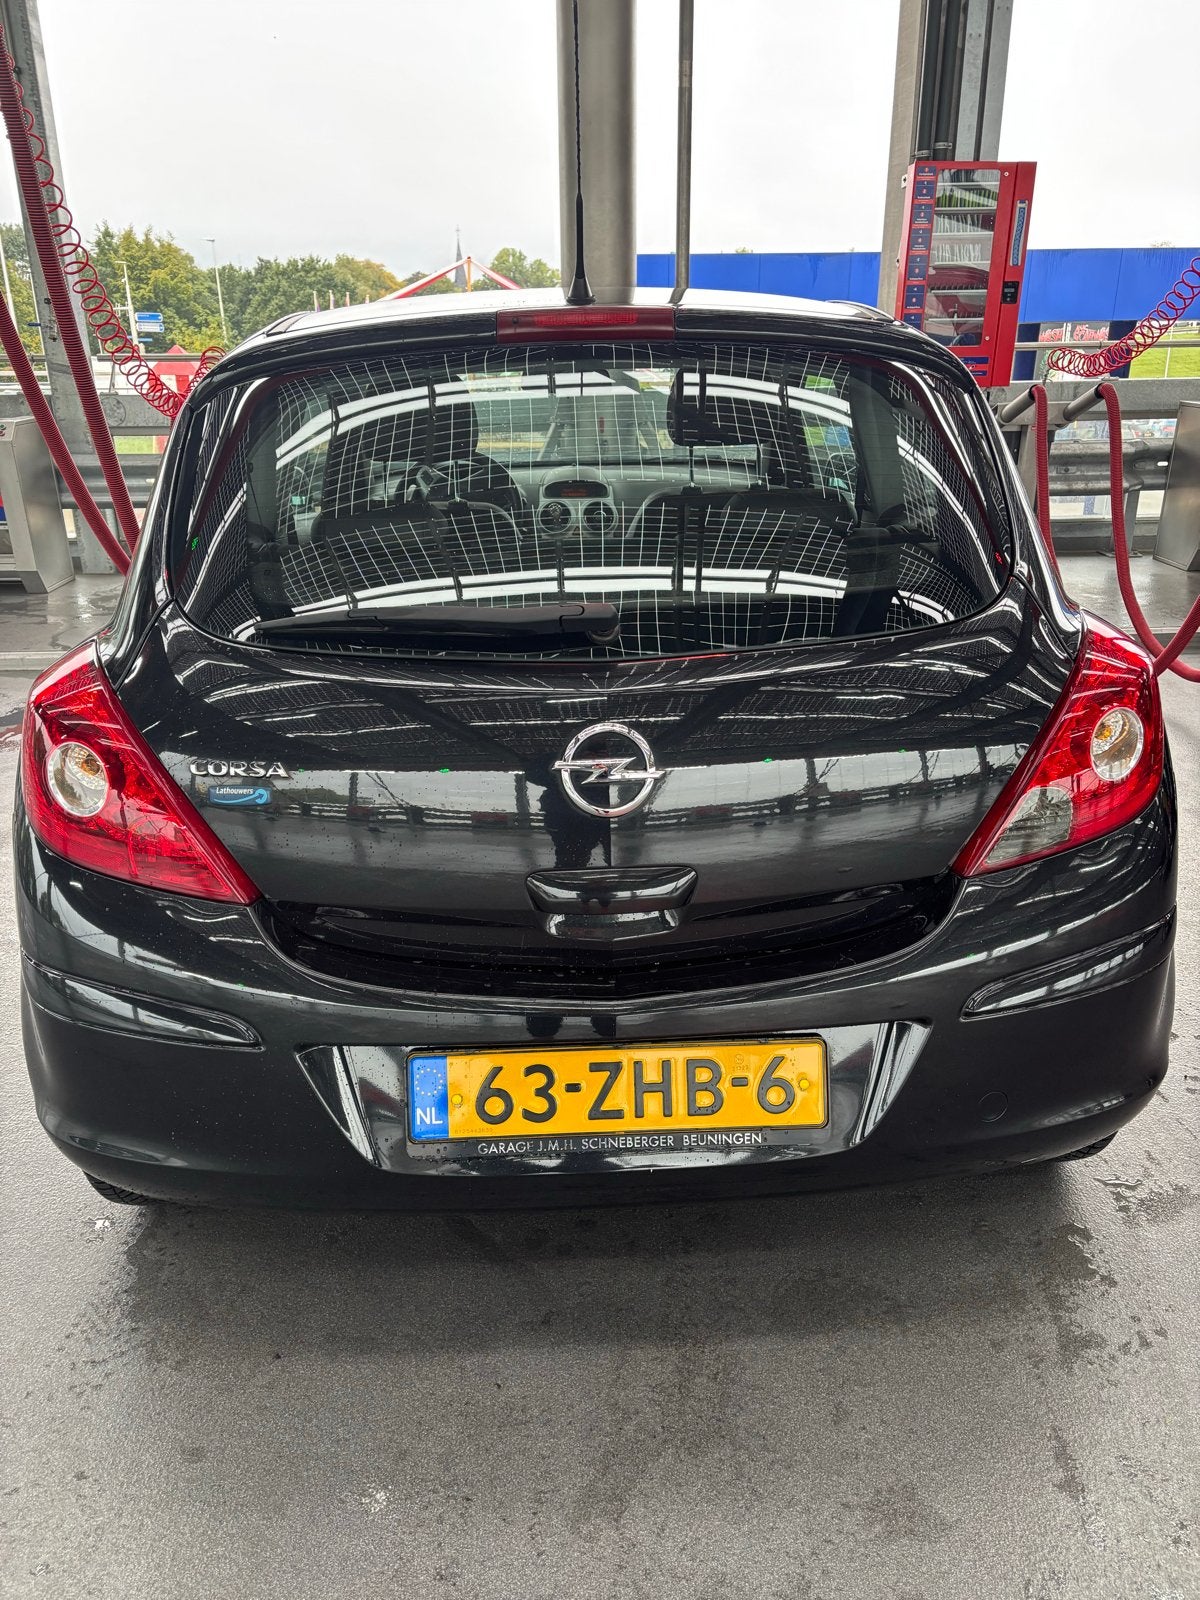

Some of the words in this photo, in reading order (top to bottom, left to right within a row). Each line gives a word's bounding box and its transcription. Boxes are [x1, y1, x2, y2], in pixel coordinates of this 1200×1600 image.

[189, 759, 290, 778] CORSA
[216, 787, 254, 795] Lathouwers
[475, 1056, 796, 1125] 63-ZHB-6
[416, 1107, 443, 1126] NL
[477, 1140, 534, 1155] GARAGE
[581, 1135, 675, 1150] SCHNEBERGER
[683, 1133, 762, 1147] BEUNINGEN
